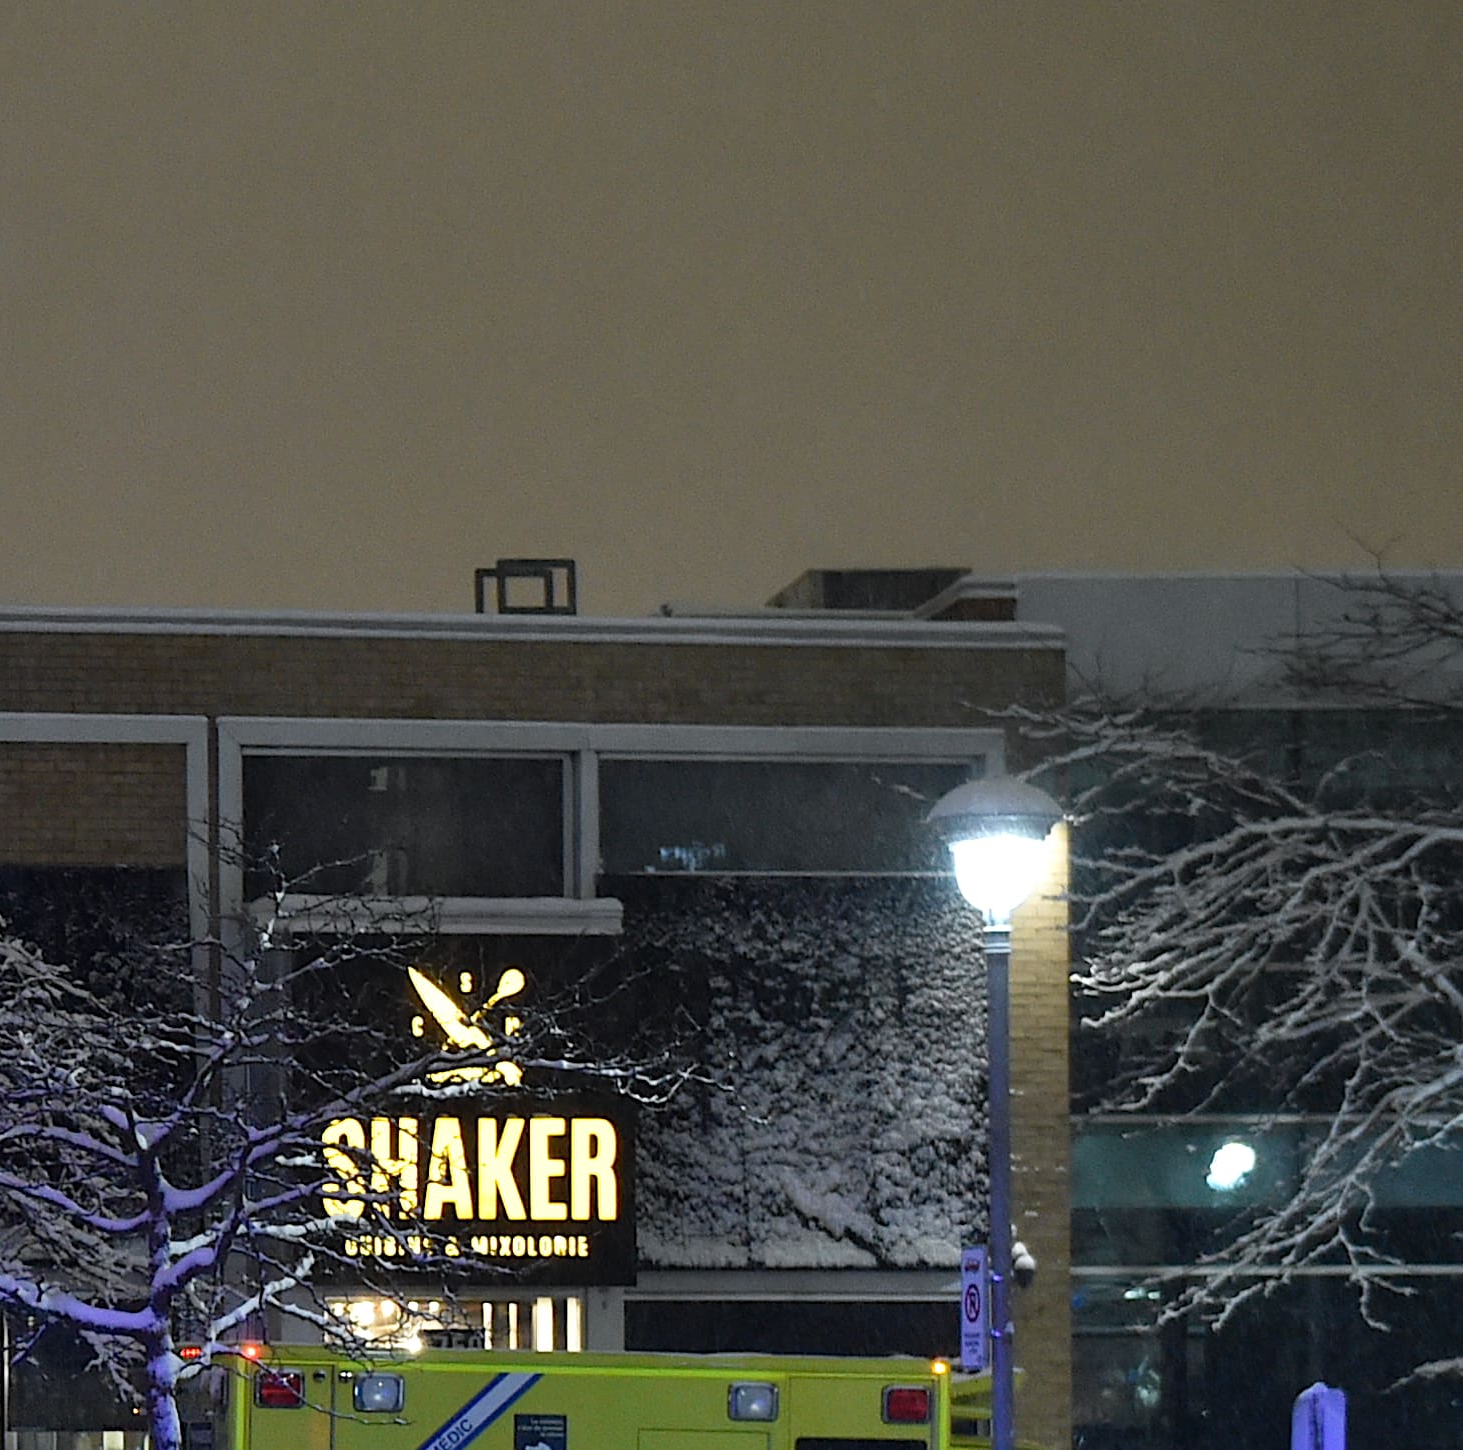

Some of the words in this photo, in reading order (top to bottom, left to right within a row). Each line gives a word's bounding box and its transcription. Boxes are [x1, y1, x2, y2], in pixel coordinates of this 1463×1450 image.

[460, 972, 472, 992] S
[412, 1016, 424, 1037] C
[322, 1117, 616, 1220] SHAKER
